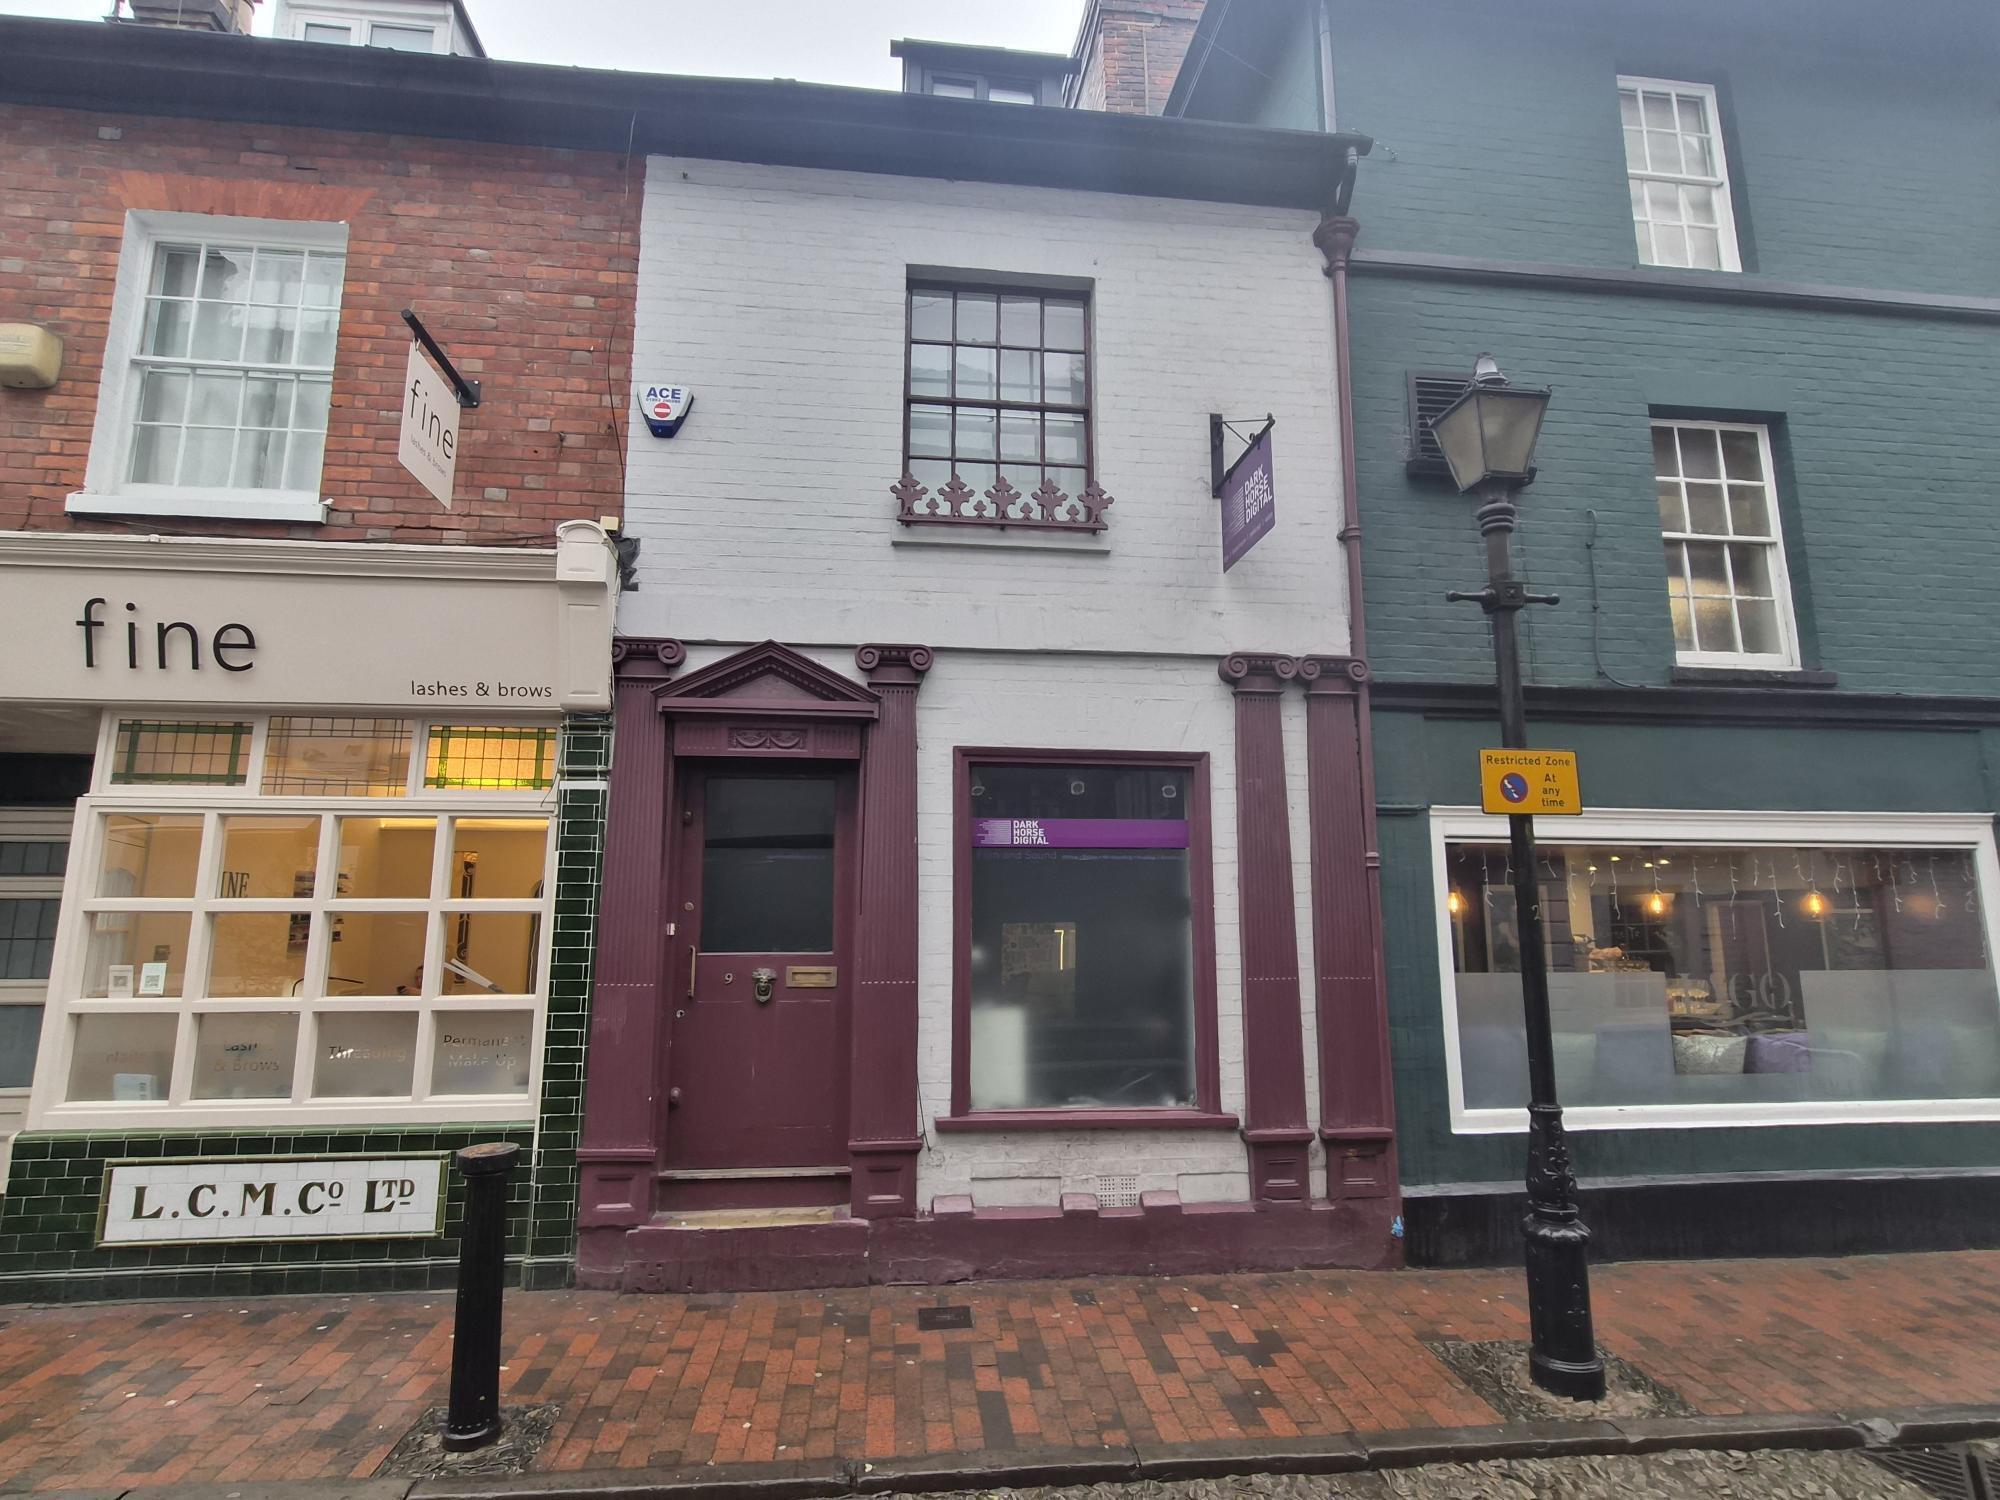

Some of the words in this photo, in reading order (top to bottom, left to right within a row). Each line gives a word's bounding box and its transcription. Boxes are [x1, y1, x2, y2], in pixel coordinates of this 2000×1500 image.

[646, 386, 682, 399] ACE
[411, 379, 453, 459] fine
[1245, 464, 1263, 495] DARK
[1245, 474, 1269, 508] HORSE
[1246, 487, 1272, 523] DIGITAL
[76, 597, 257, 672] fine
[411, 680, 468, 696] lashes
[475, 682, 490, 696] &
[498, 682, 552, 697] brows
[1486, 755, 1540, 765] Restricted
[1545, 756, 1571, 766] Zone
[1544, 773, 1556, 782] At
[1542, 787, 1560, 796] any
[1541, 798, 1565, 807] time
[1013, 820, 1039, 829] DARK
[1013, 829, 1045, 837] HORSE
[1013, 836, 1049, 845] DIGITAL
[725, 973, 733, 985] 9
